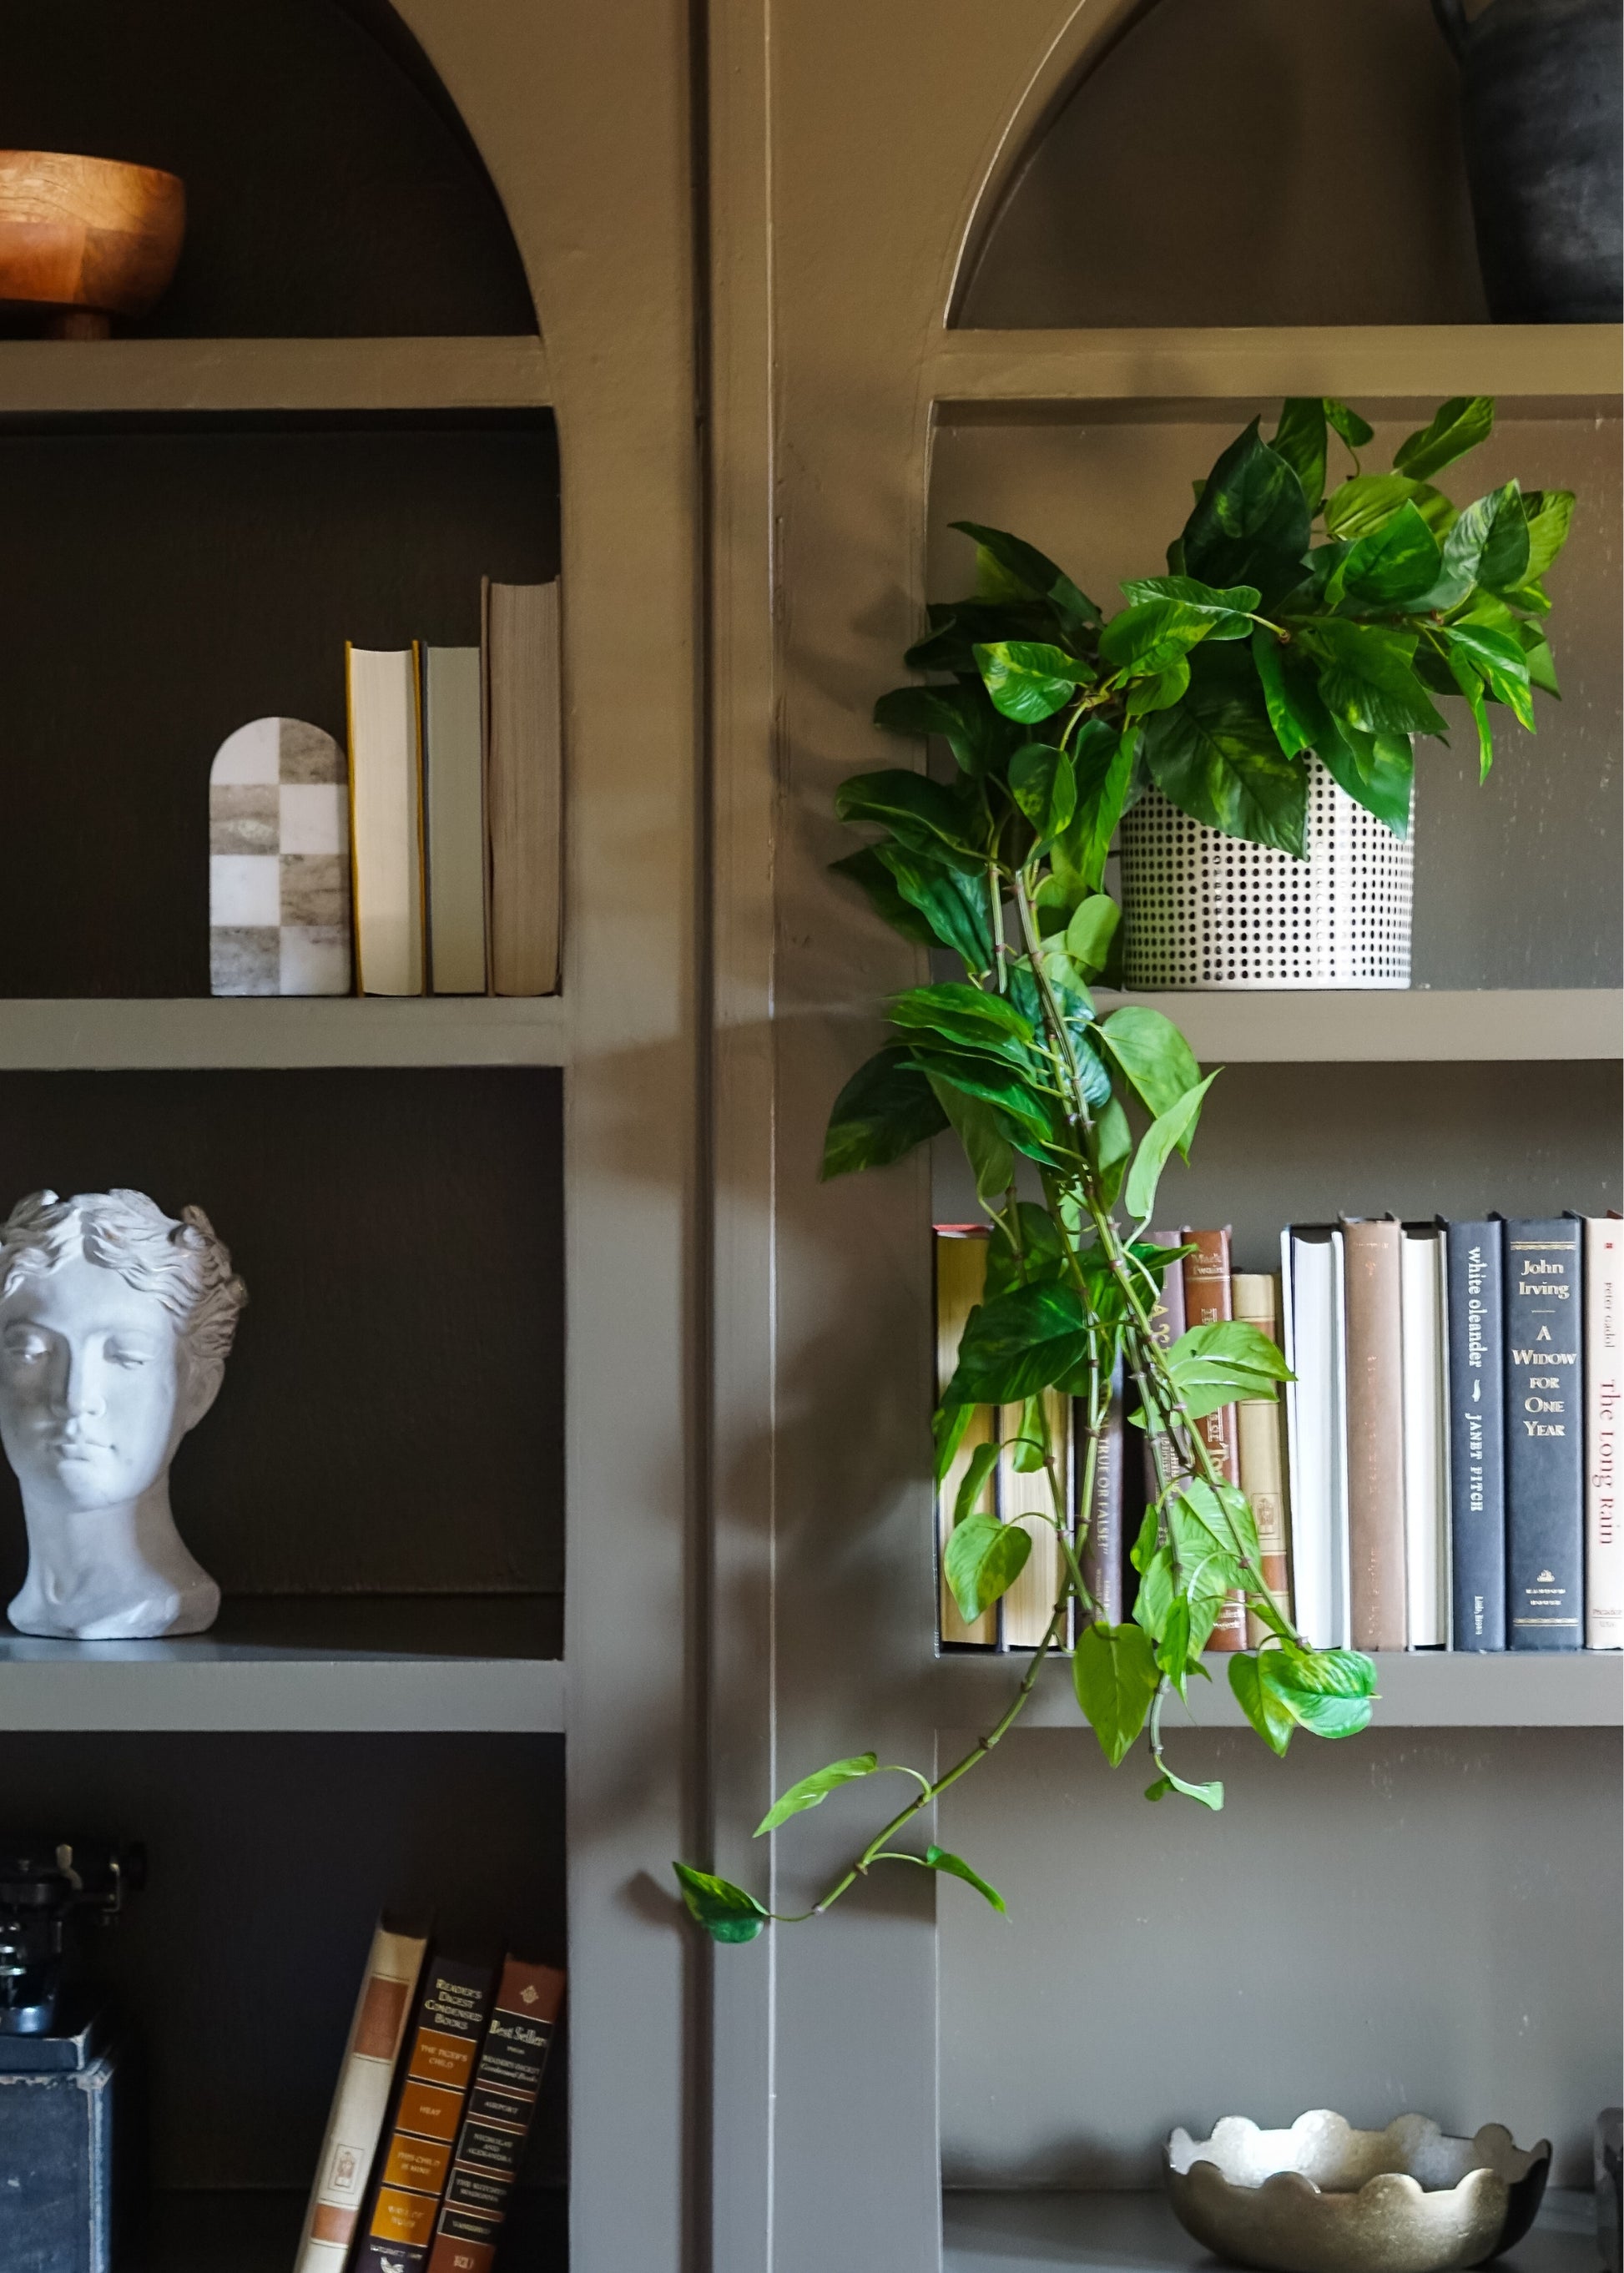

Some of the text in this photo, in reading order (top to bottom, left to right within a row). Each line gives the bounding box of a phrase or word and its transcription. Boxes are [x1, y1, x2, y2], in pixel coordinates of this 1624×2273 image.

[1521, 1259, 1564, 1276] John
[1519, 1281, 1571, 1299] Irving
[1468, 1246, 1488, 1368] white oleander
[1536, 1325, 1552, 1341] A
[1511, 1349, 1577, 1365] WIDOW
[1529, 1377, 1561, 1389] FOR
[1524, 1396, 1565, 1413] ONE
[1465, 1413, 1483, 1460] JANET
[1523, 1420, 1566, 1437] YEAR
[1591, 1379, 1621, 1545] The Long Rain
